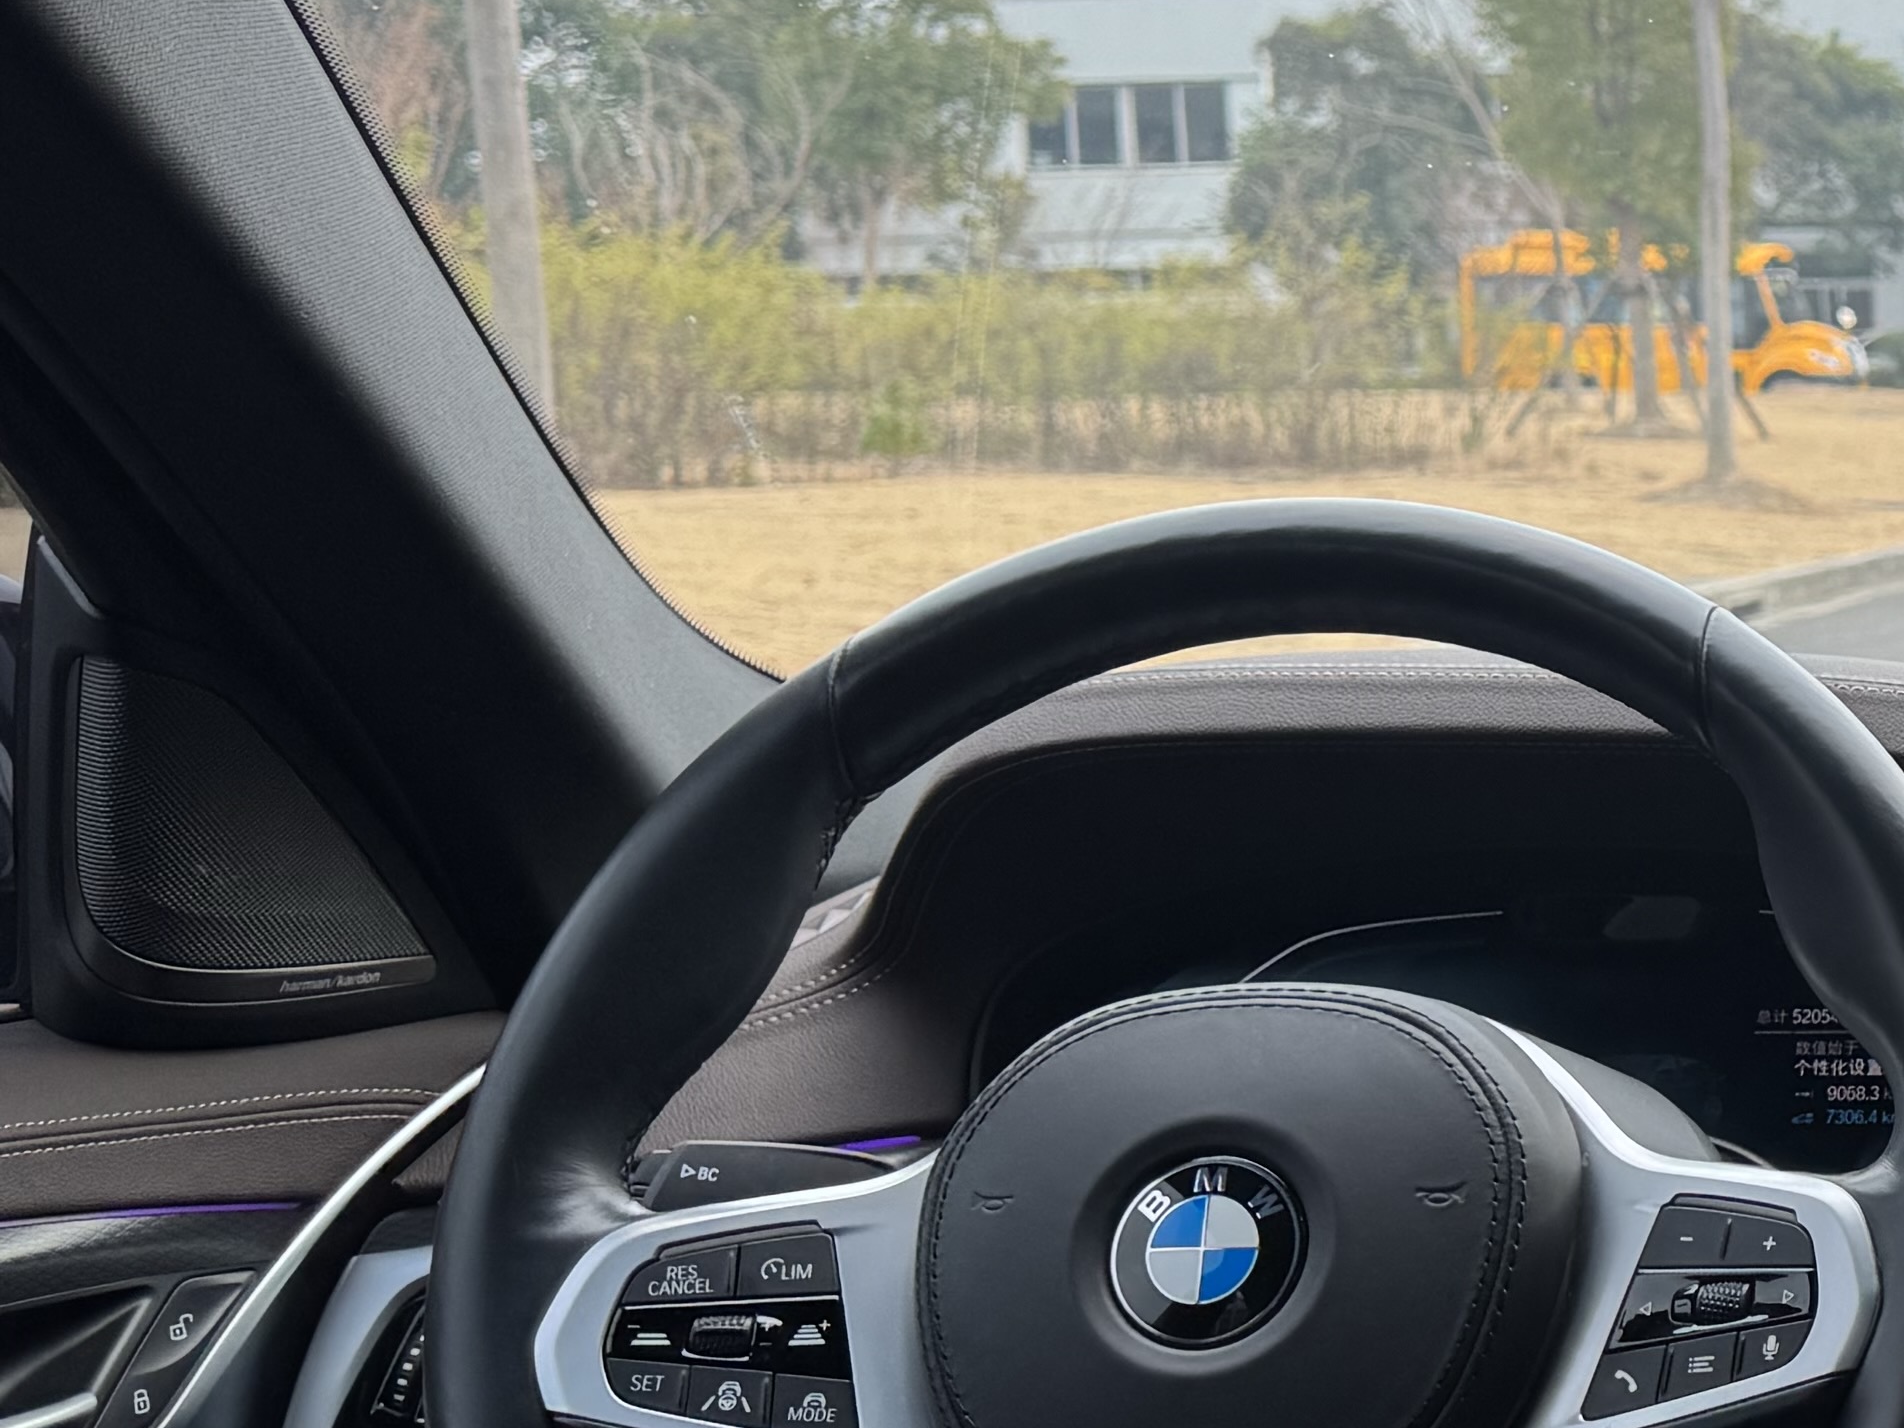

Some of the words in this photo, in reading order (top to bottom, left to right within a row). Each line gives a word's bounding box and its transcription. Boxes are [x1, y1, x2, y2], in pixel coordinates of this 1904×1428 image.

[1825, 1109, 1878, 1124] 7306.4
[697, 1166, 720, 1182] BC
[1137, 1166, 1285, 1223] BMW
[666, 1264, 699, 1281] RES
[781, 1263, 814, 1280] LIM
[648, 1276, 715, 1297] CANCEL
[630, 1375, 665, 1392] SET
[787, 1407, 837, 1423] MODE
